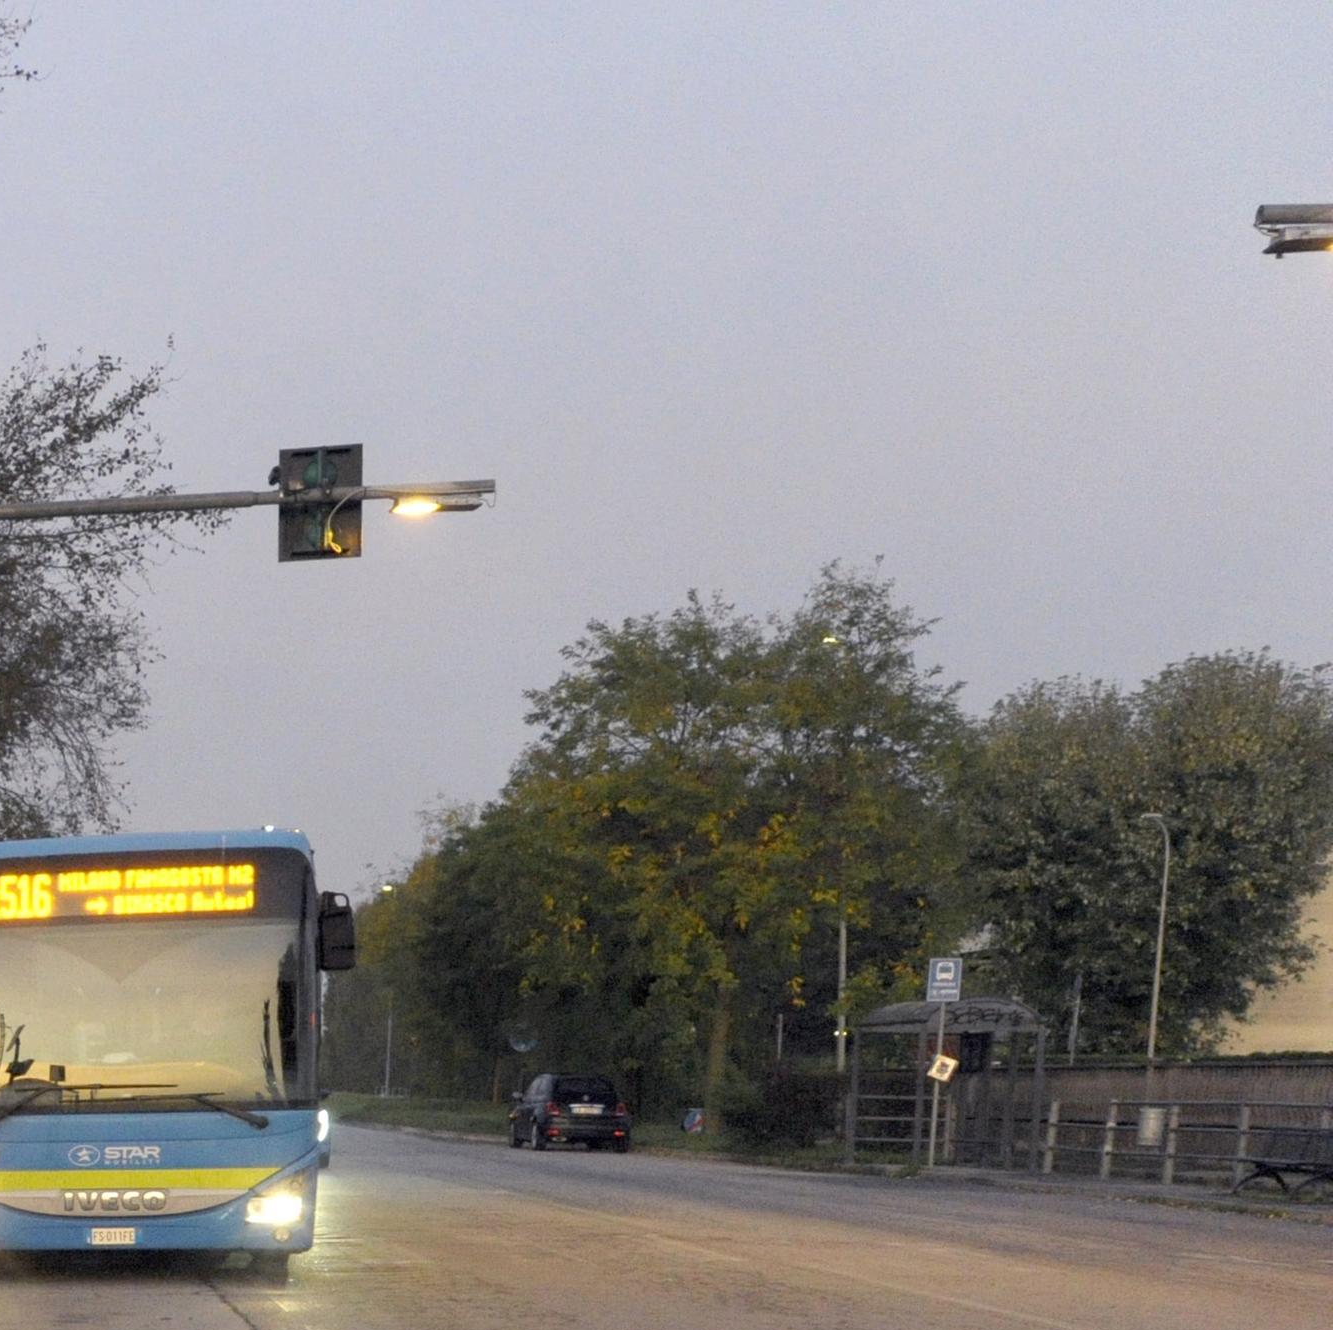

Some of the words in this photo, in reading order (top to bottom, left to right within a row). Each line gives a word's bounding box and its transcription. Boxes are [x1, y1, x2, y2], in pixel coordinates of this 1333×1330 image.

[58, 870, 121, 892] MILANO
[104, 1146, 161, 1159] STAR
[64, 1191, 167, 1211] IVECO
